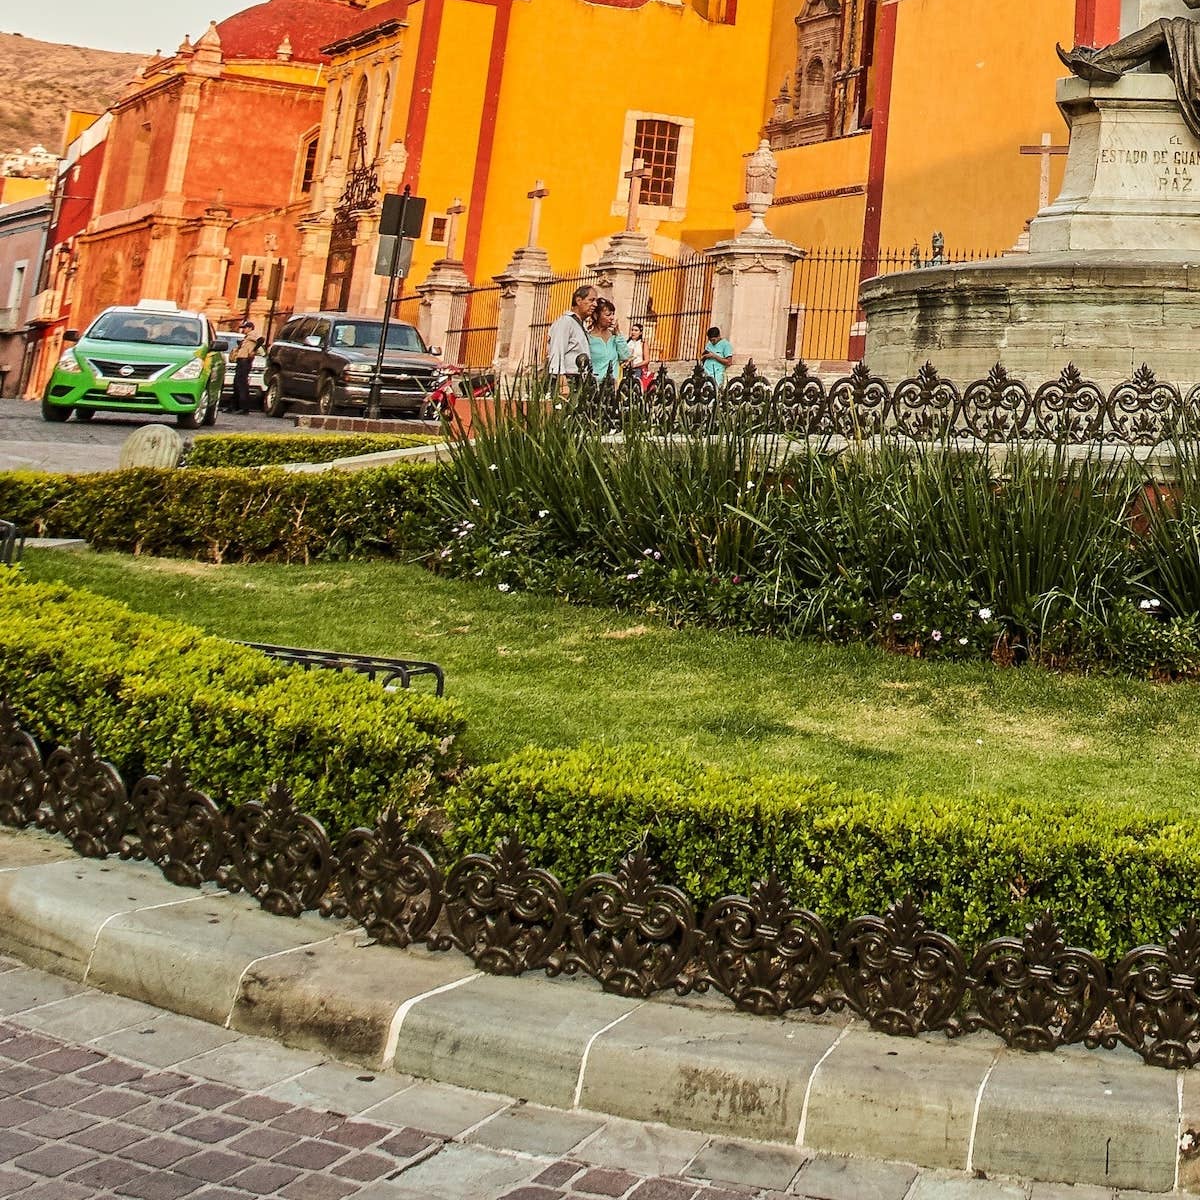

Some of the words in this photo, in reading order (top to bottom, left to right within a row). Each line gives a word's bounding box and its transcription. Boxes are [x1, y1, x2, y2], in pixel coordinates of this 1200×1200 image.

[1101, 149, 1148, 164] ESTADO
[1153, 150, 1168, 165] DE
[1164, 167, 1170, 175] A
[1174, 167, 1188, 175] LA
[1159, 177, 1192, 192] PAZ
